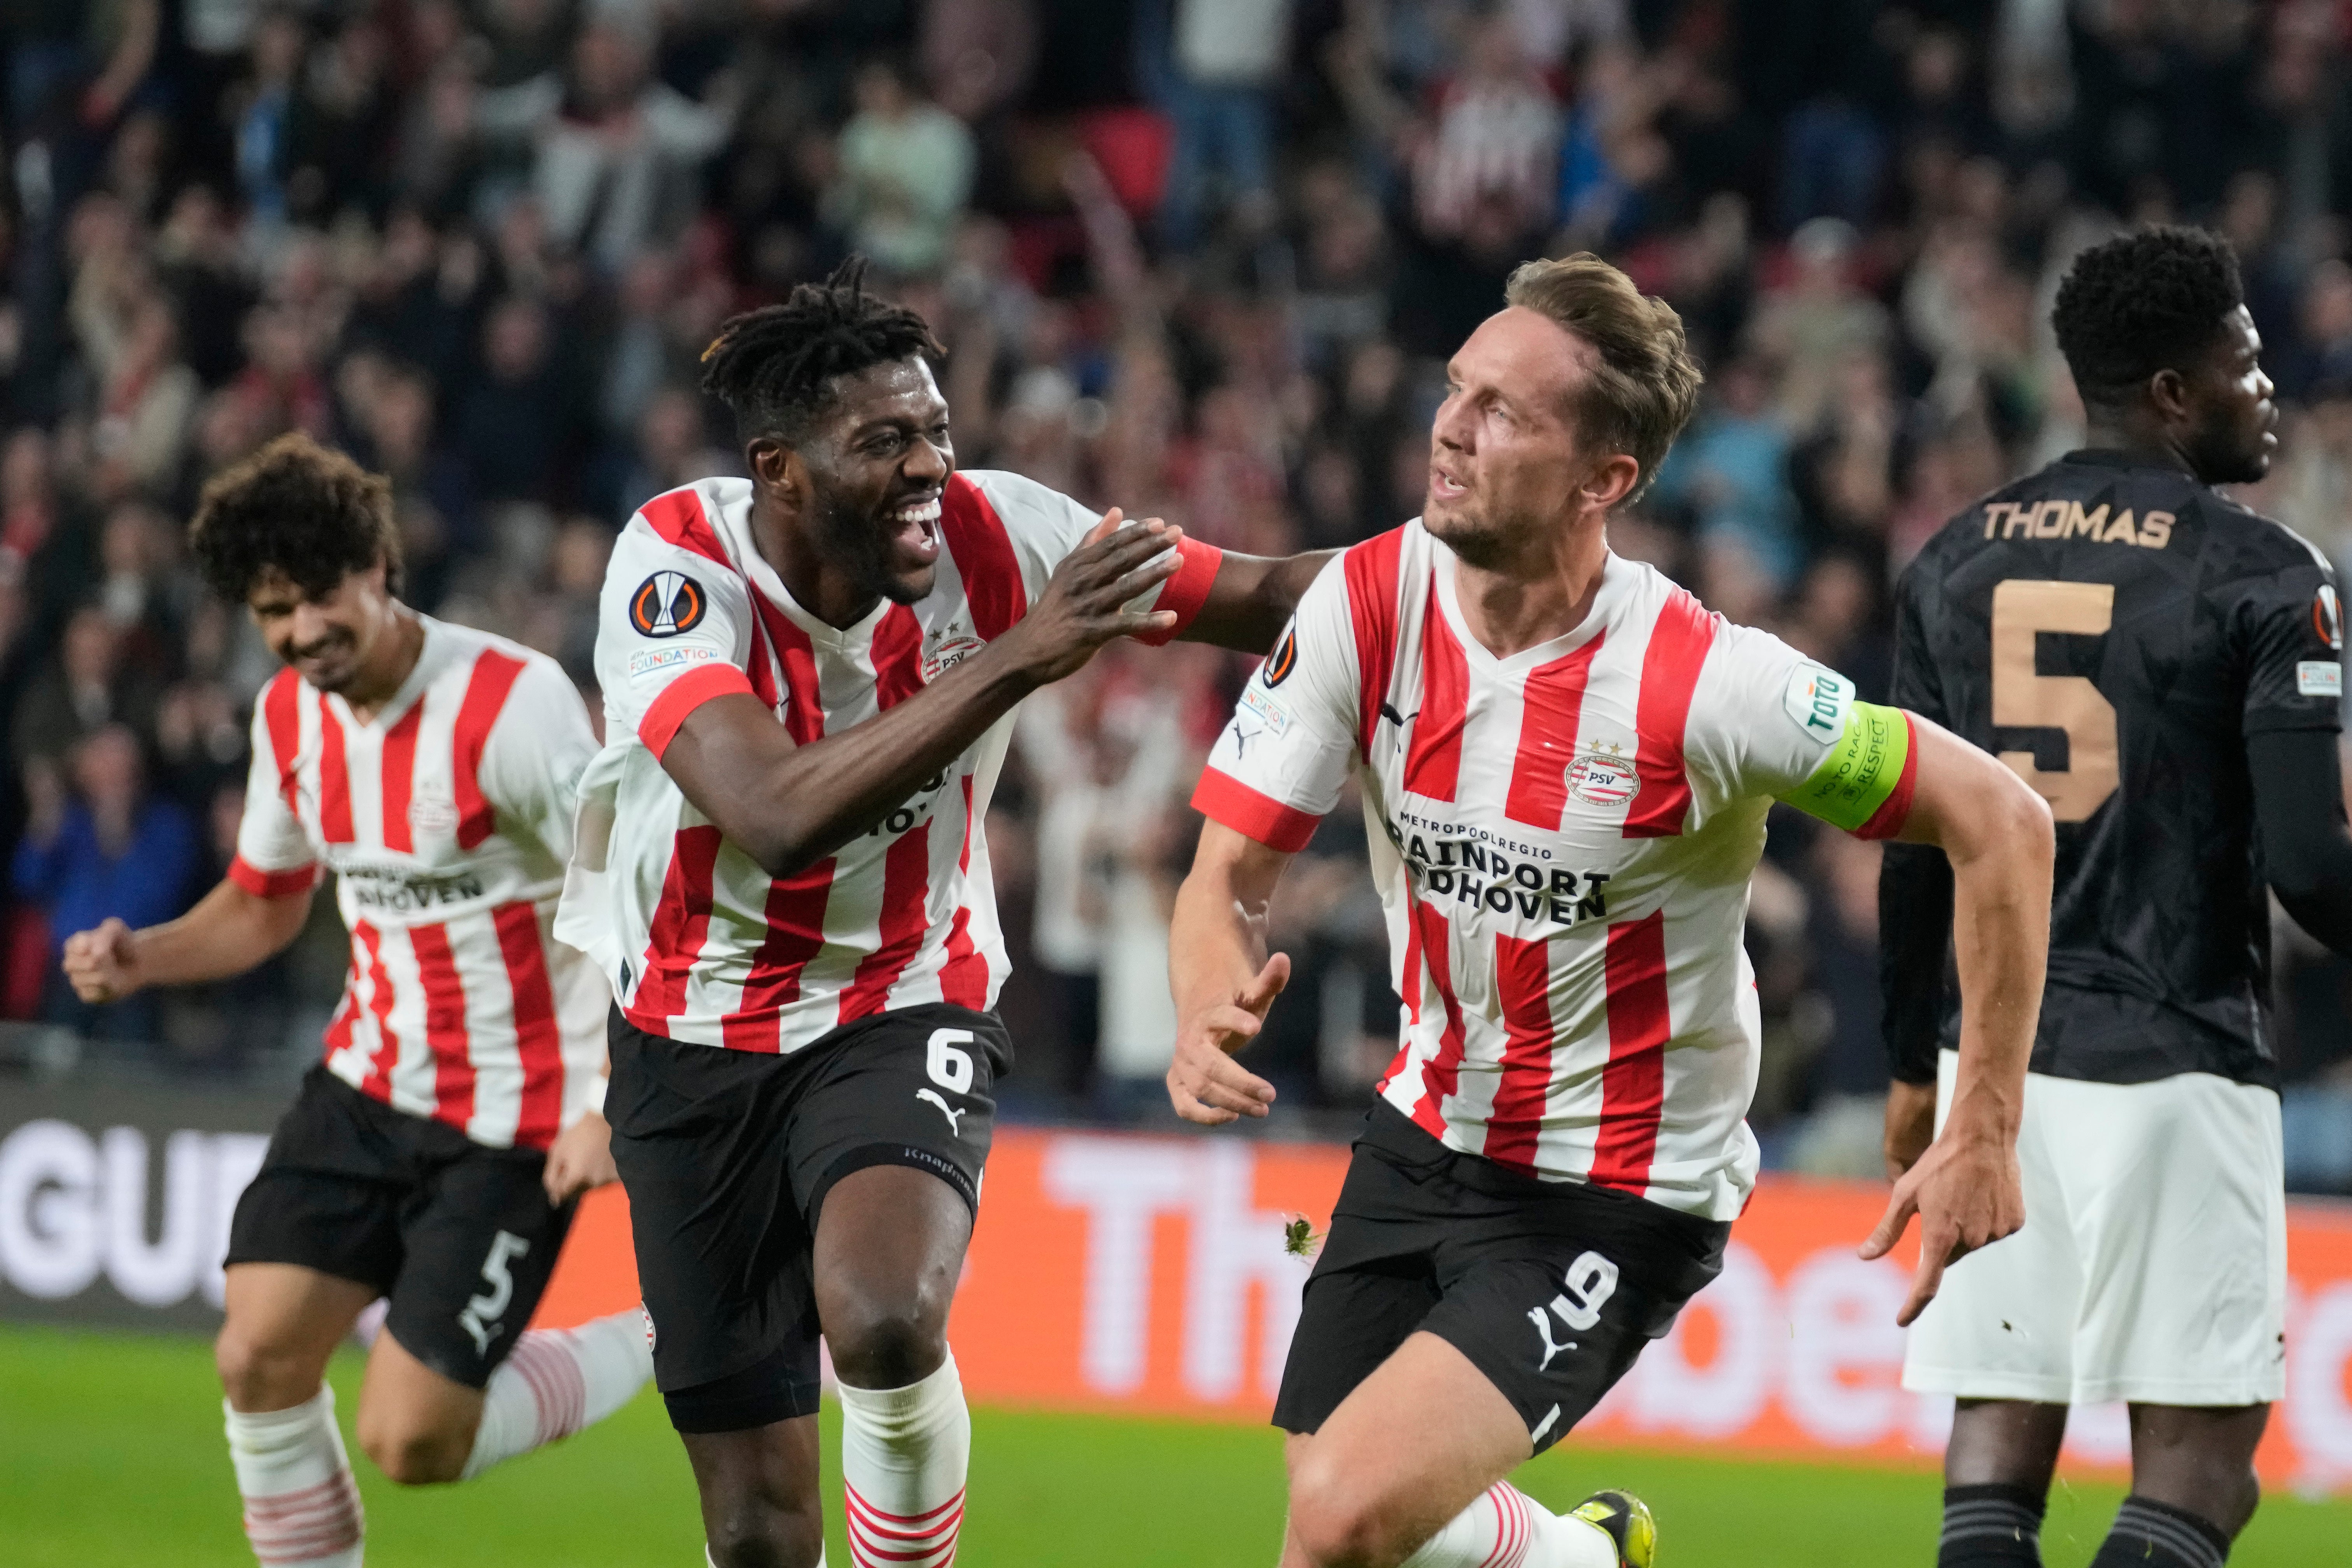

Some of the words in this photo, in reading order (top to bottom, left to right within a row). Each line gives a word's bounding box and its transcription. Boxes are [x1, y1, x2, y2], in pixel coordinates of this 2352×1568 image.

[1983, 499, 2176, 550] THOMAS
[630, 649, 718, 670] FOUNDATION
[942, 651, 965, 668] PSV
[1807, 675, 1840, 731] TOTO
[1991, 579, 2121, 823] 5
[1588, 772, 1616, 785] PSV
[1856, 718, 1885, 784] RESPECT
[1400, 810, 1552, 860] METROPOOLREGIO
[926, 1027, 975, 1095] 6
[481, 1229, 531, 1322] 5
[1550, 1250, 1619, 1332] 9
